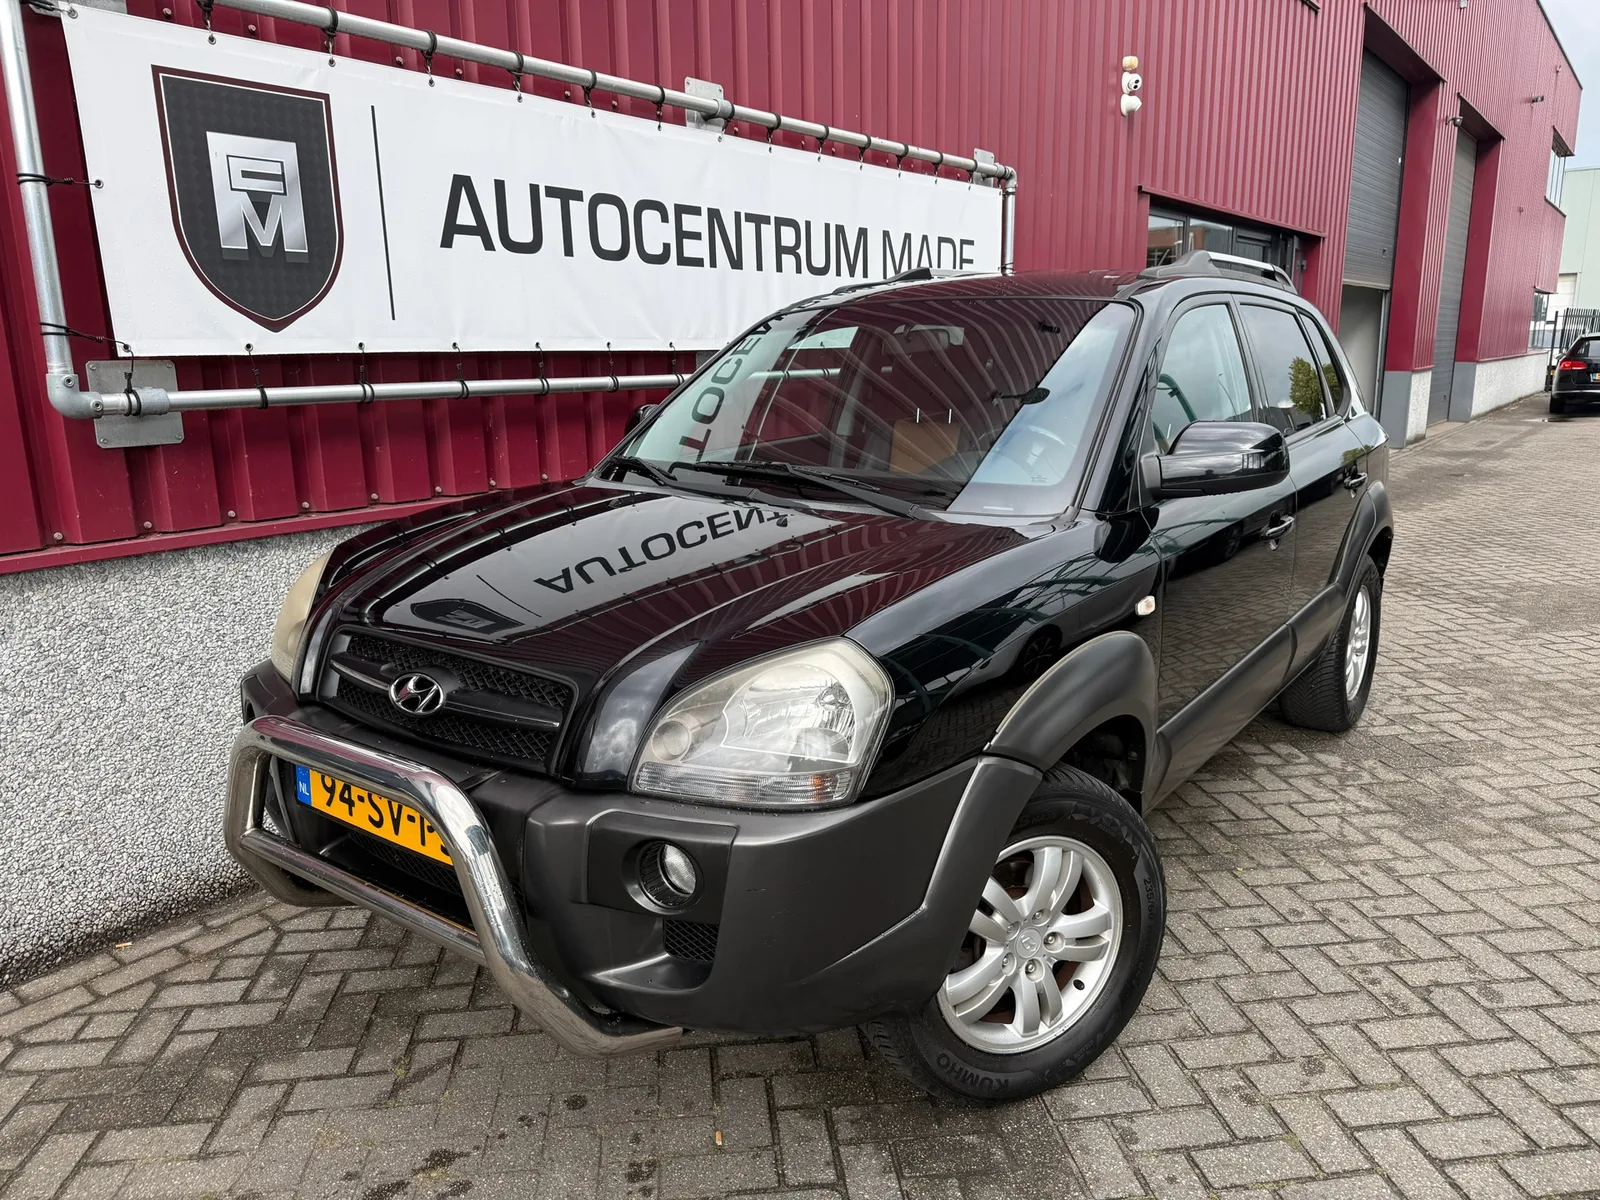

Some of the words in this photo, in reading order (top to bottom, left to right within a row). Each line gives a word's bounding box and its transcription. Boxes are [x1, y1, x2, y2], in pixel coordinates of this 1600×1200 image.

[440, 173, 869, 279] AUTOCENTRUM
[882, 230, 975, 280] MADE
[299, 781, 310, 796] NL
[935, 1053, 1010, 1095] KUMHO
